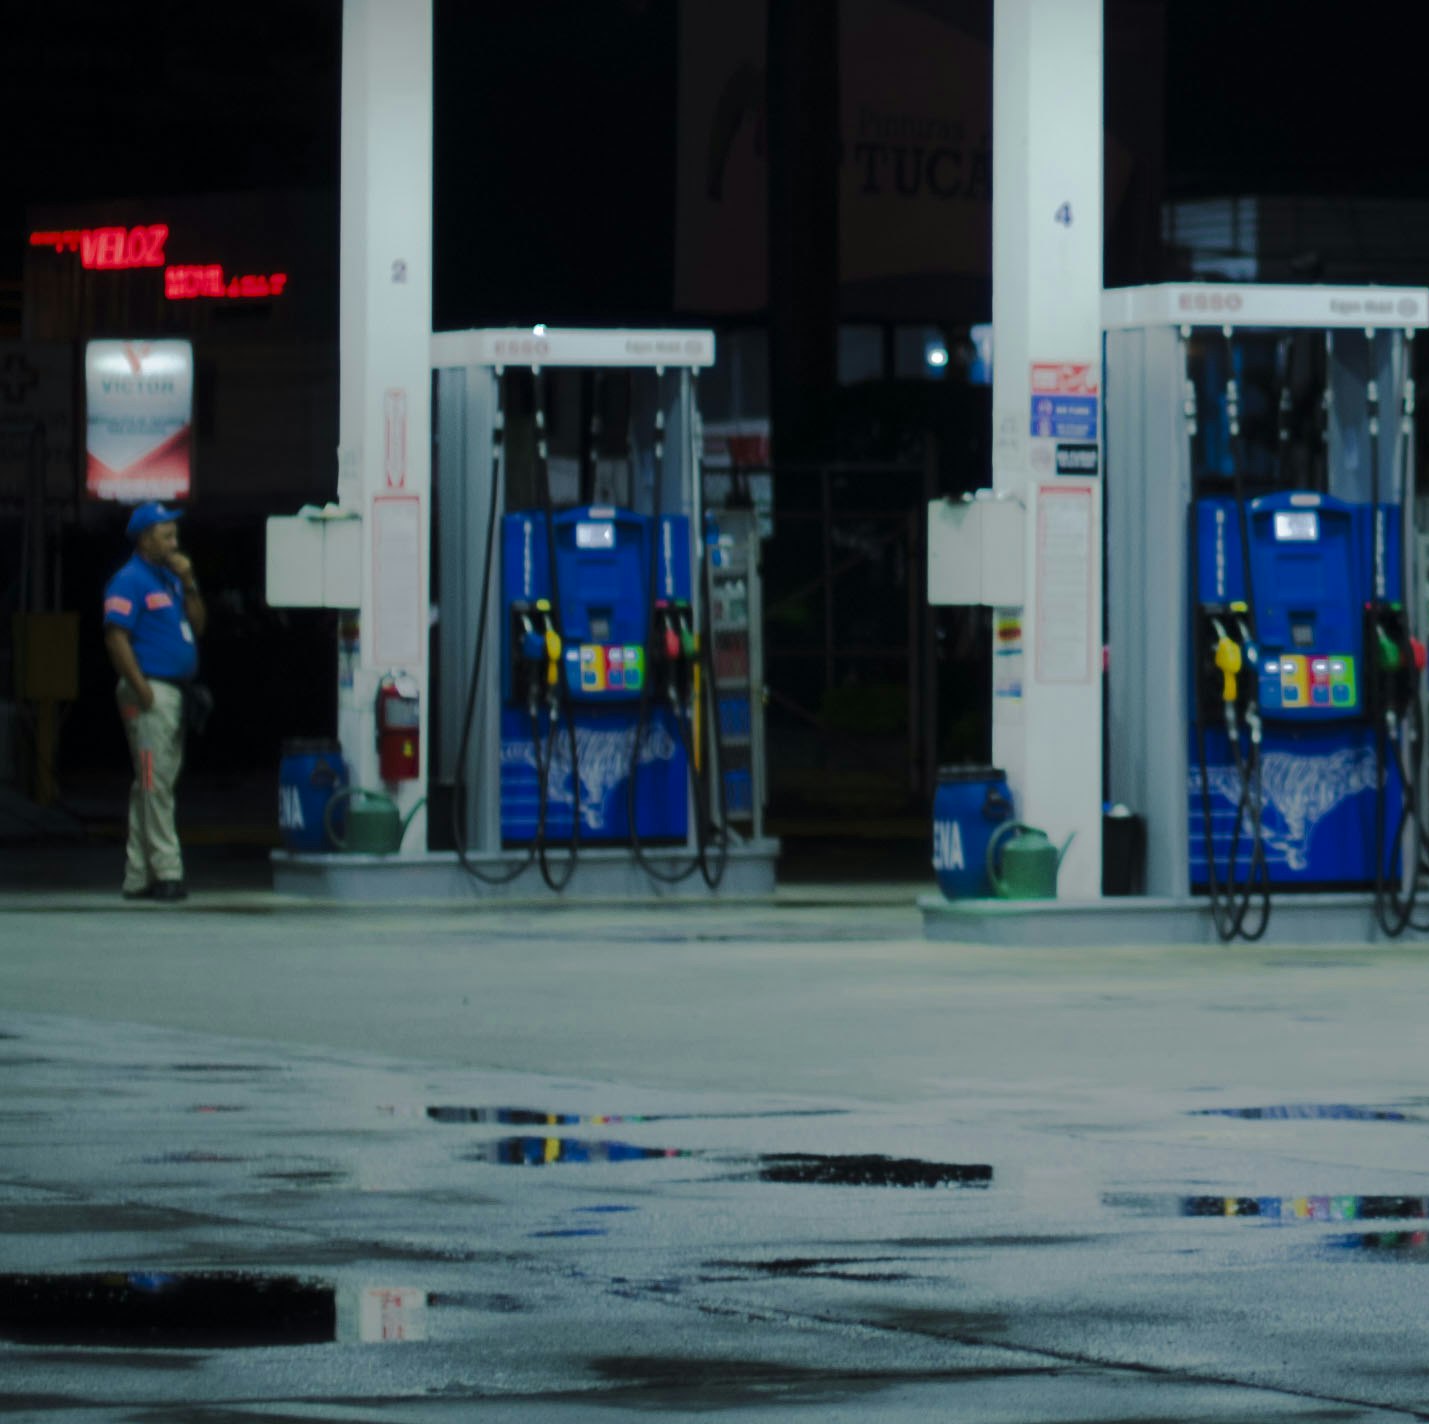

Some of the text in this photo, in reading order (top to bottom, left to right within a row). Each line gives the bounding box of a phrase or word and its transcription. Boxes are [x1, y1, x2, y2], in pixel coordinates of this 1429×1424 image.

[1054, 200, 1073, 228] 4
[81, 224, 169, 270] VELOZ
[391, 259, 407, 284] 2
